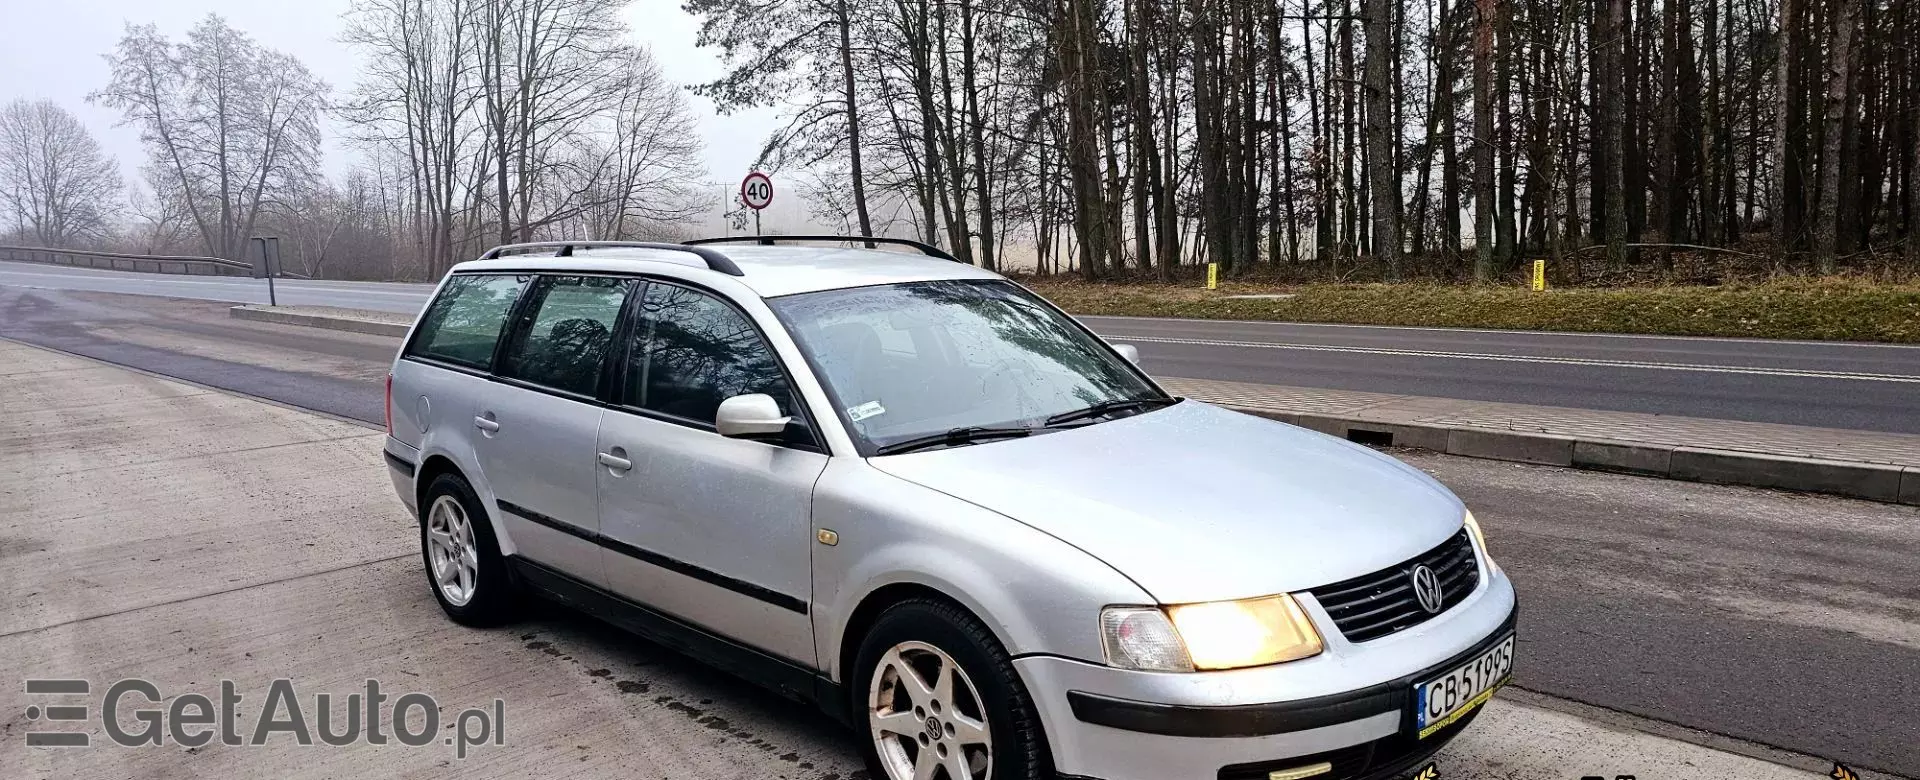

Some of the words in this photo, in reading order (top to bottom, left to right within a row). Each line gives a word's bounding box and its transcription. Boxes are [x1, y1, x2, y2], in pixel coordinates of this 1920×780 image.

[748, 183, 769, 200] 40
[1430, 673, 1457, 718] CB
[1462, 641, 1511, 700] 5199S
